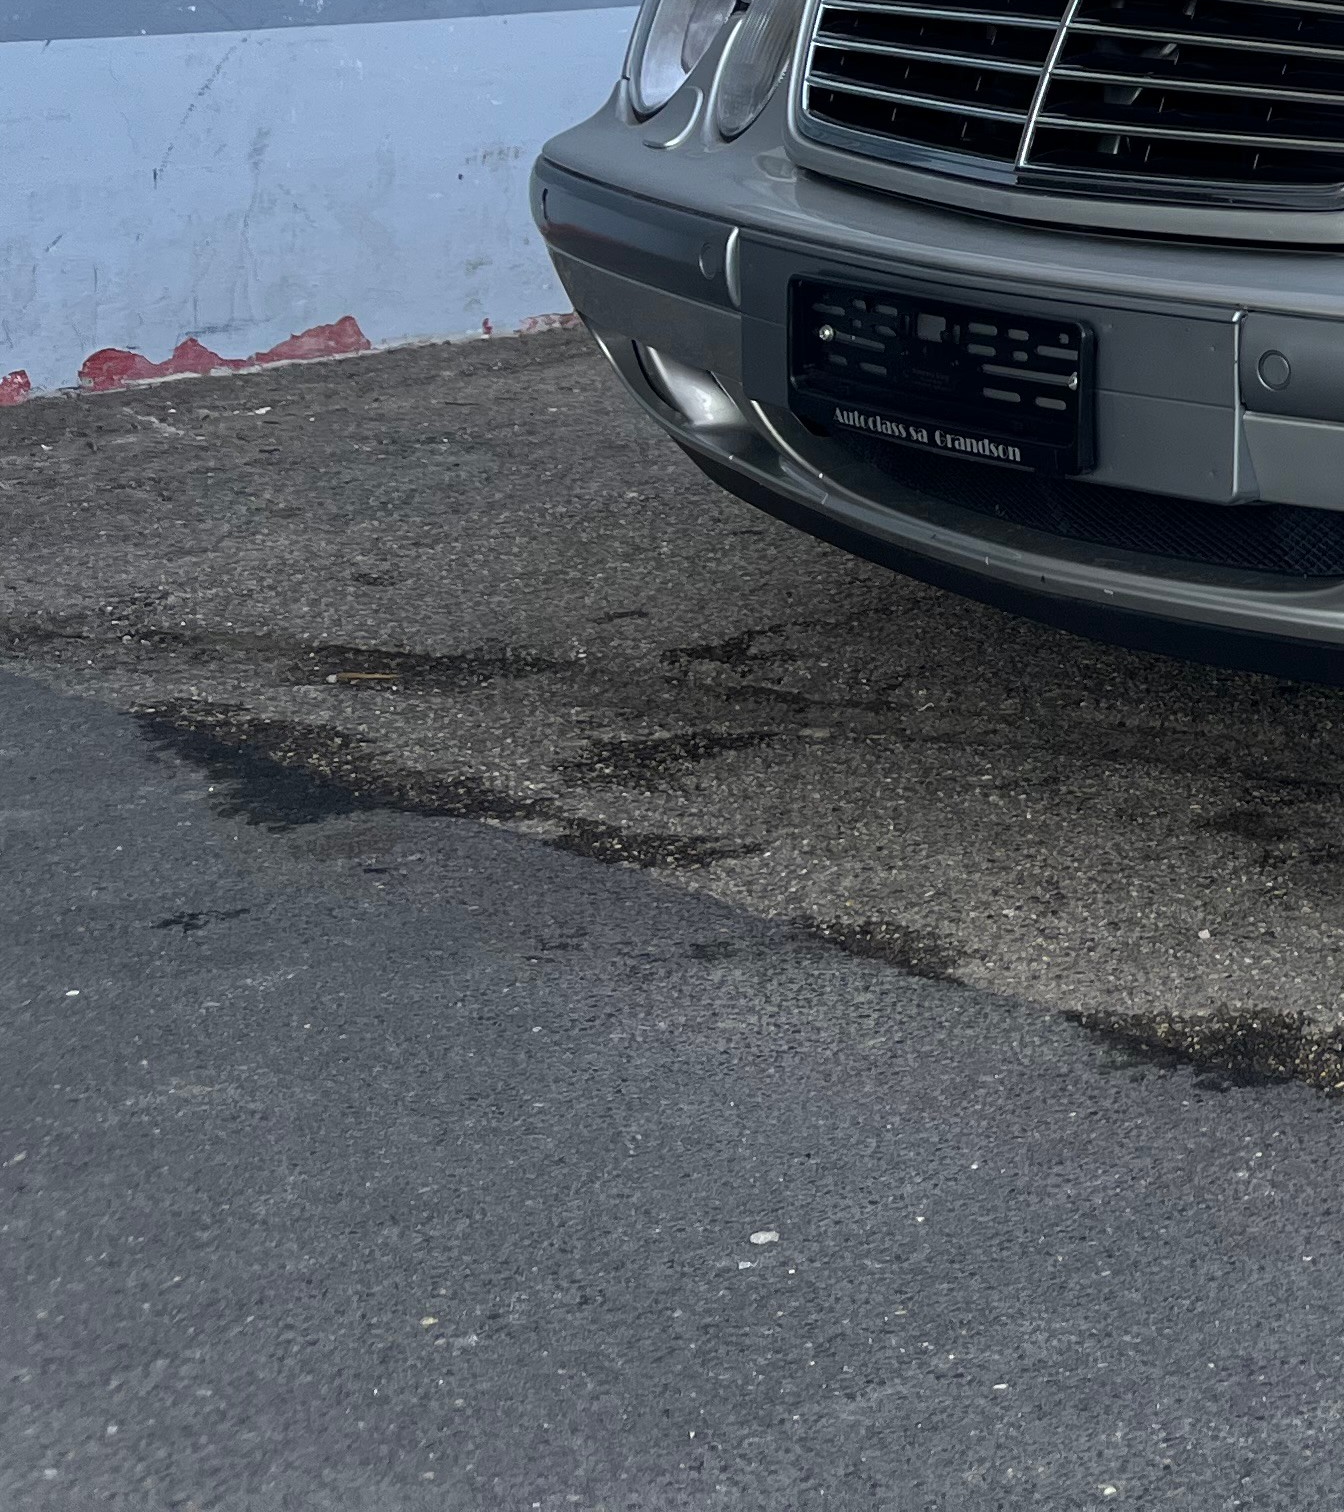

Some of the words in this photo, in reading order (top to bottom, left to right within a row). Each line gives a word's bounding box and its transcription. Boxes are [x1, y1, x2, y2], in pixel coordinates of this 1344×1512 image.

[833, 407, 907, 438] Autoclass
[909, 425, 929, 444] sa
[934, 429, 1022, 463] Grandson
